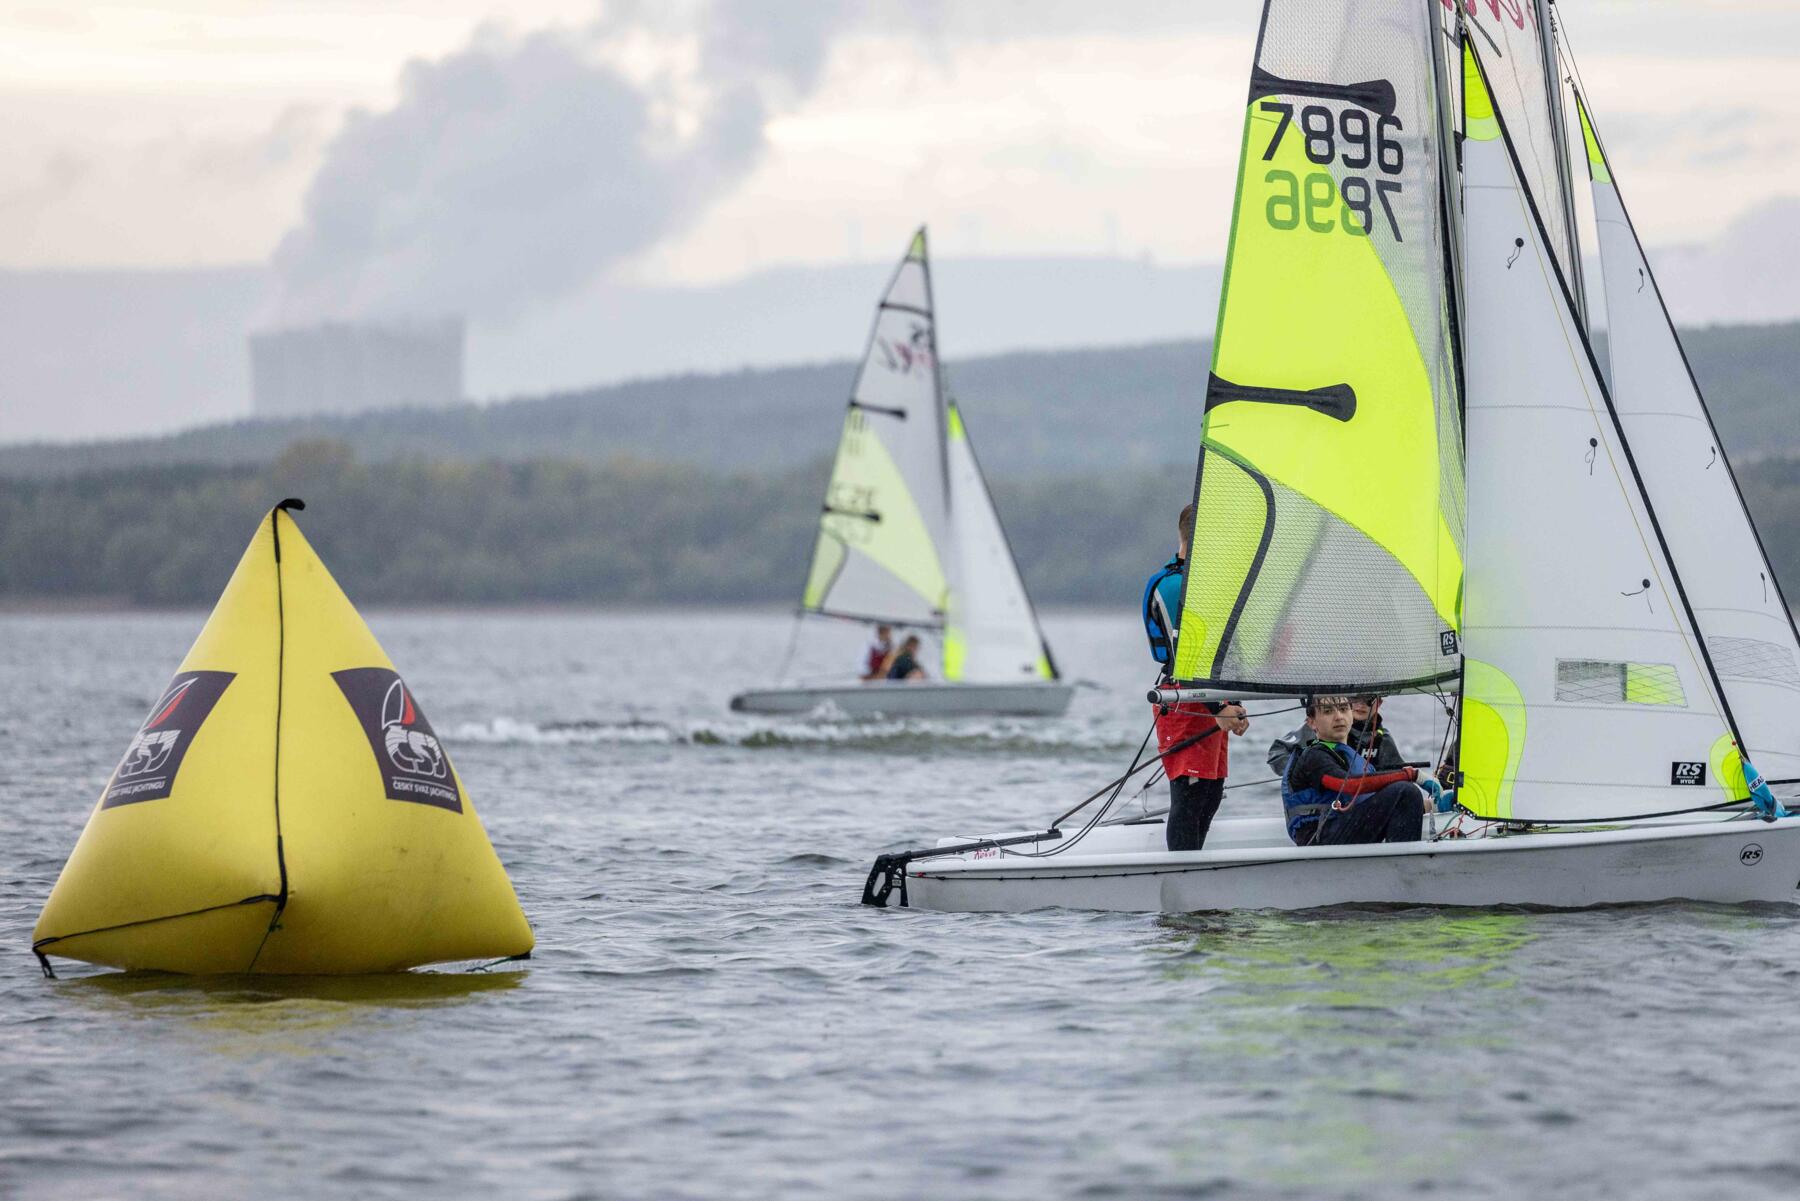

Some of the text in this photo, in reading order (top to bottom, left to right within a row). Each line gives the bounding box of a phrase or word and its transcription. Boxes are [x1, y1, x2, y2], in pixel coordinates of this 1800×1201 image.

[1260, 101, 1404, 175] 7896
[1443, 632, 1454, 646] RS
[1361, 748, 1378, 758] HH
[1676, 763, 1703, 776] RS
[1741, 850, 1762, 860] RS
